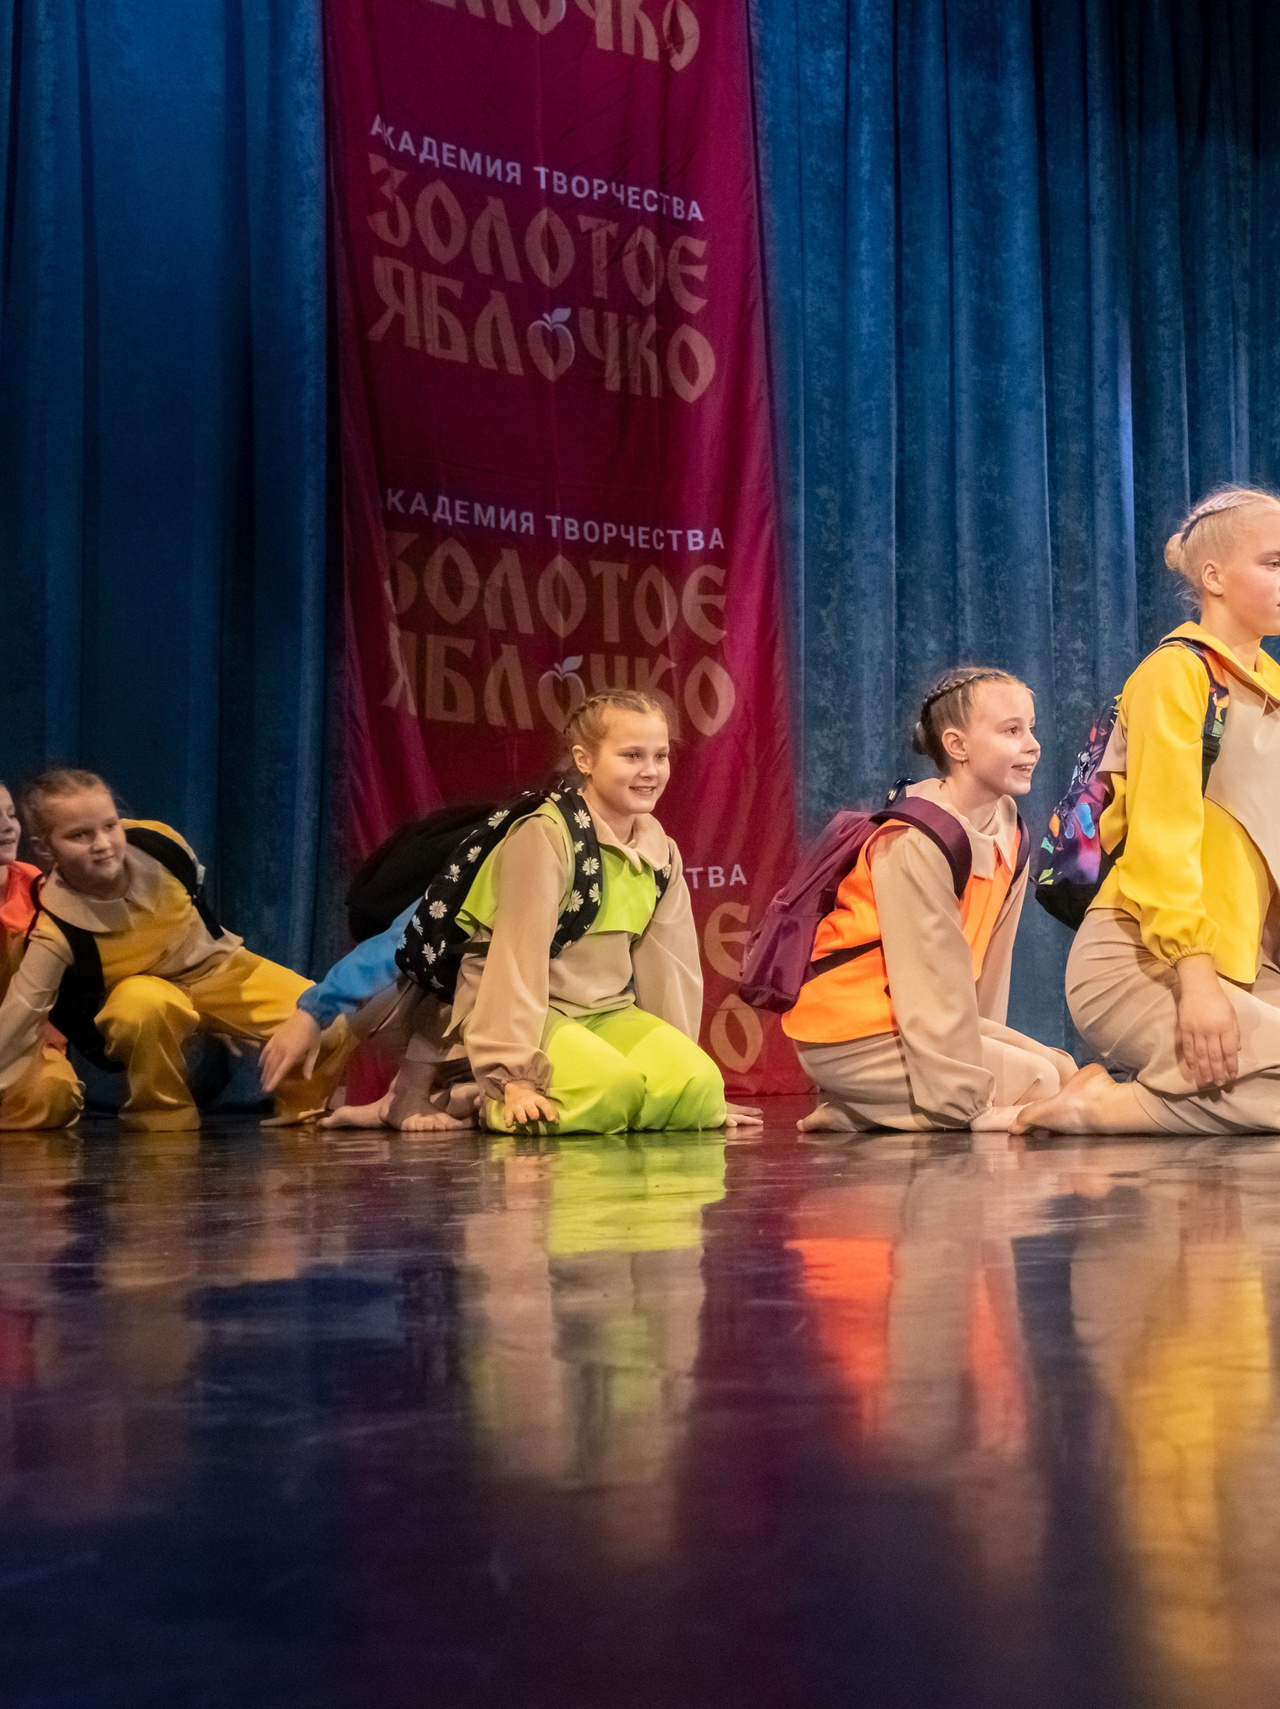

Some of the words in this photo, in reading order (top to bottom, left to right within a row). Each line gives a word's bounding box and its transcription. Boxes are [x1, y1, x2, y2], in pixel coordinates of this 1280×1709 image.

[367, 152, 710, 315] ЗОЛОТОЕ
[533, 166, 705, 222] ТВОРЧЕСТВА
[366, 255, 717, 404] ЯБЛОЧКО
[385, 487, 536, 536] КАДЕМИЯ
[545, 514, 725, 552] ТВОРЧЕСТВА
